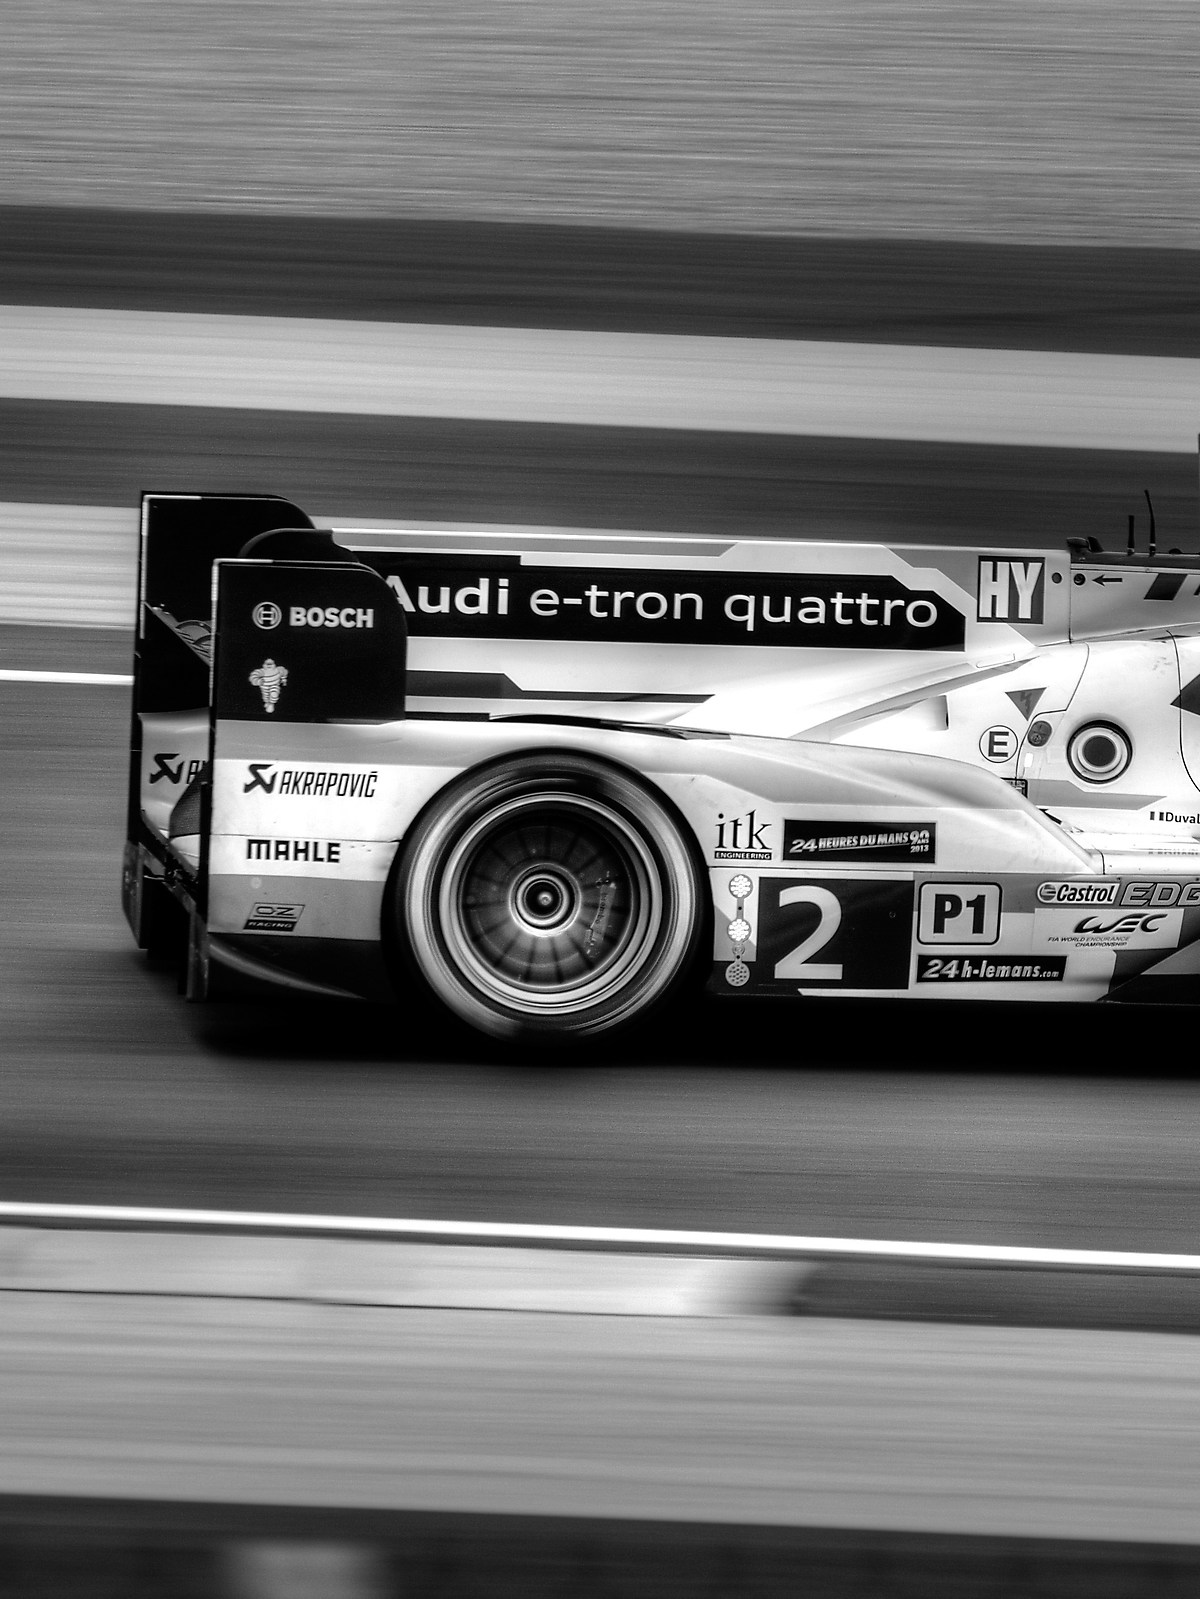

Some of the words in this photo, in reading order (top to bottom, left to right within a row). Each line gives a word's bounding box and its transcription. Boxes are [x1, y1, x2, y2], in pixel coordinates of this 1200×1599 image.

[979, 561, 1043, 619] HY
[386, 574, 510, 616] Audi
[530, 584, 703, 620] e-tron
[725, 590, 938, 632] quattro
[290, 606, 374, 628] BOSCH
[988, 731, 1009, 757] E
[1165, 811, 1200, 824] Duval
[714, 809, 772, 850] itk
[247, 839, 341, 863] MAHLE
[789, 838, 818, 853] 24
[819, 836, 858, 849] HEURES
[860, 834, 876, 846] DU
[877, 832, 909, 845] MANS
[910, 844, 930, 853] 2013
[716, 852, 771, 860] ENGINEERING
[1057, 883, 1115, 903] Castrol
[933, 893, 986, 935] P1
[1073, 912, 1169, 934] WEC
[774, 885, 843, 980] 2
